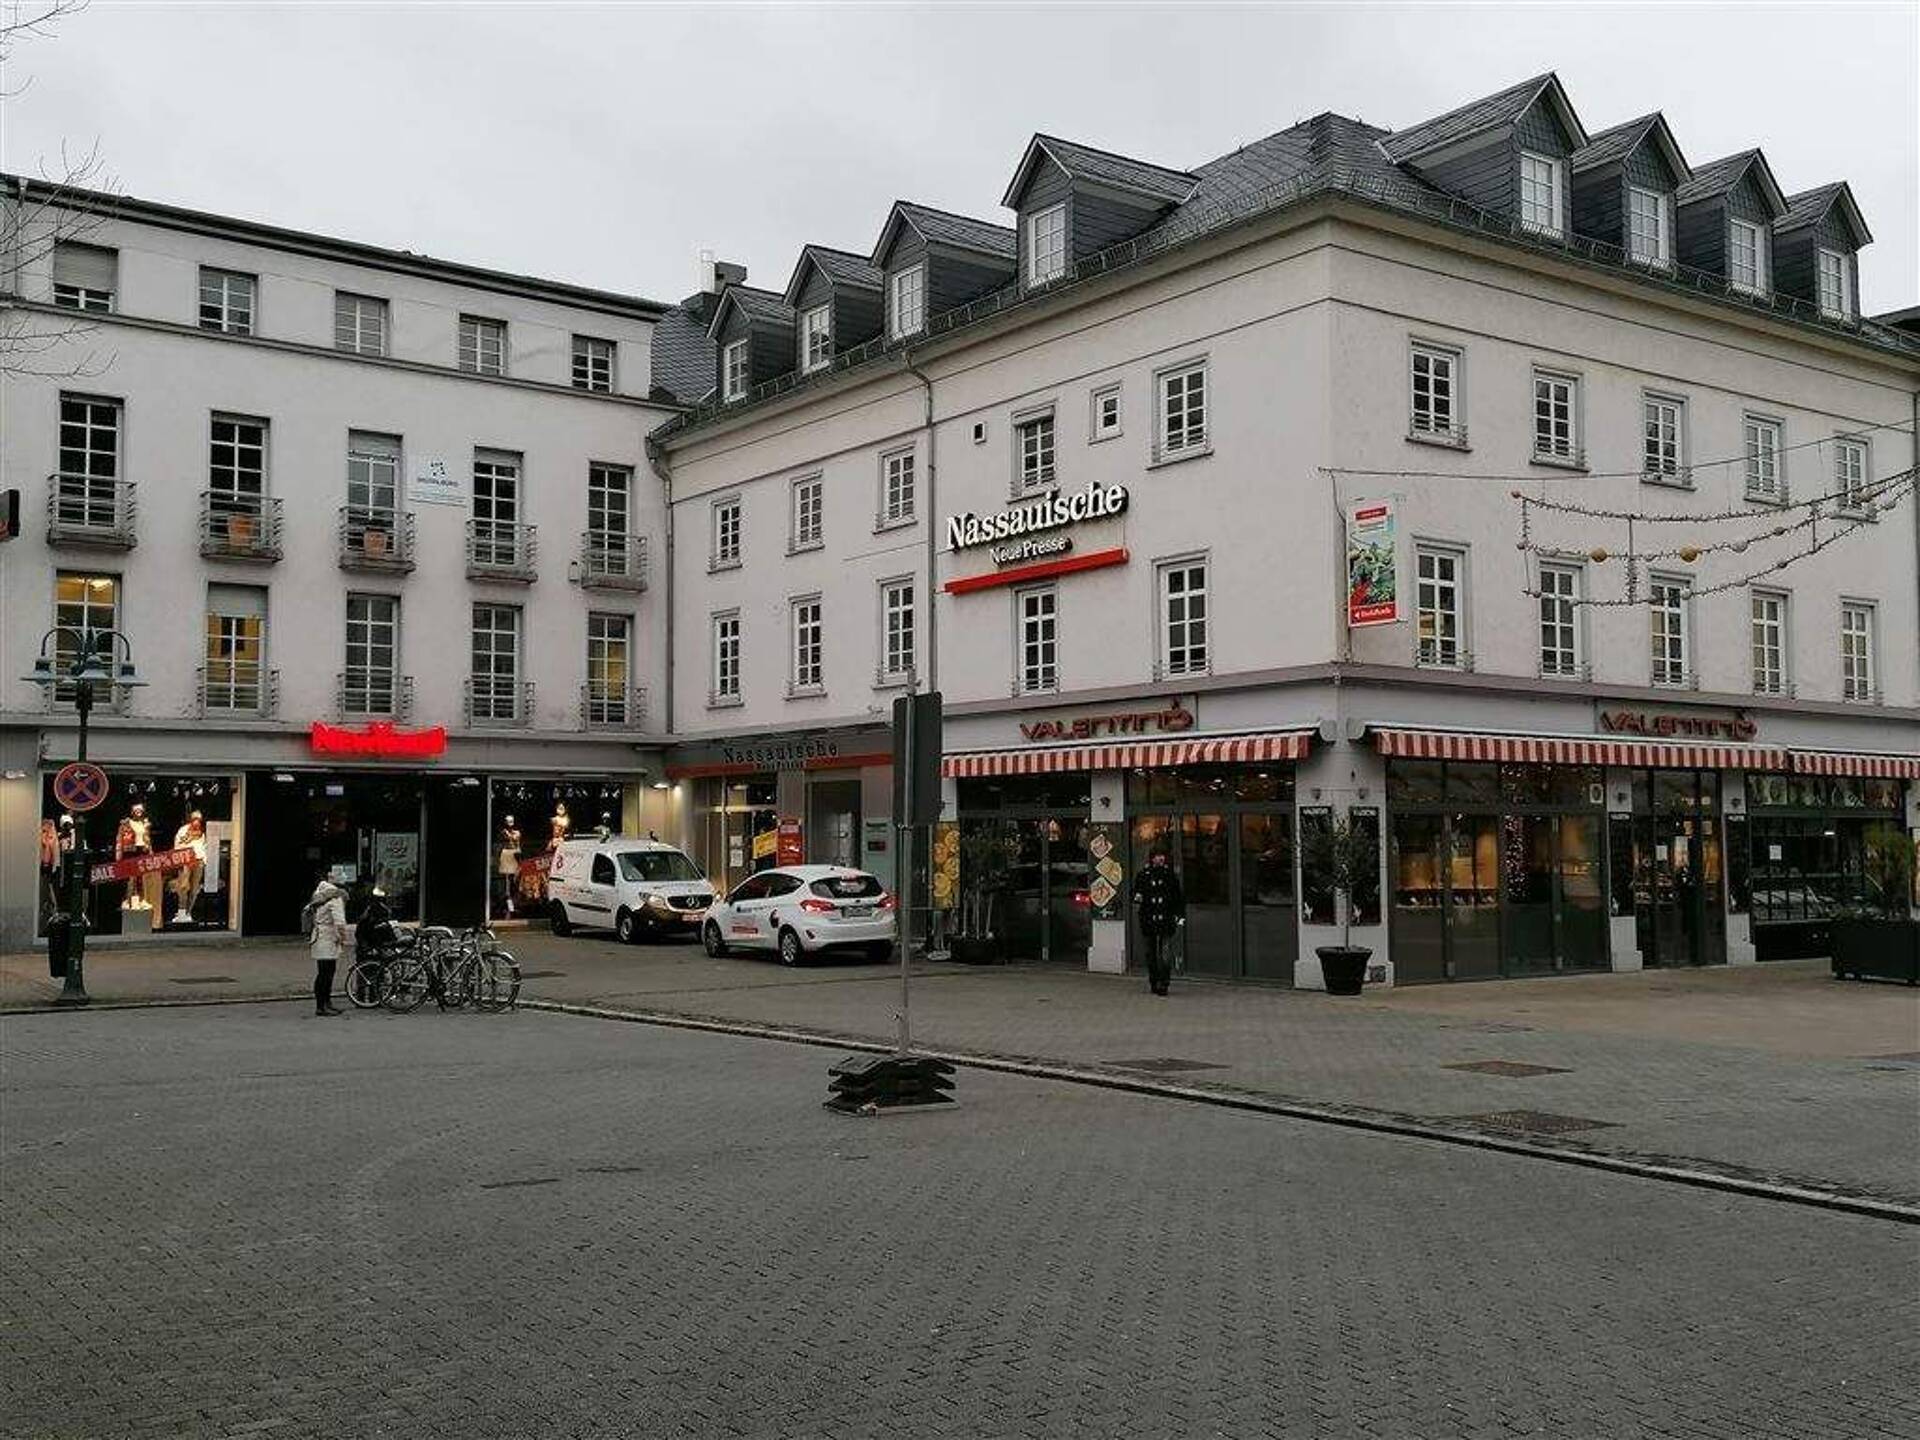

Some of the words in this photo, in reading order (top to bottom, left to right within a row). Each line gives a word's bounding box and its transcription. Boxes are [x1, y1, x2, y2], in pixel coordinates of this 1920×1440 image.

[945, 482, 1127, 551] Nassauische
[990, 546, 1023, 567] Neue
[1023, 537, 1070, 563] Presse
[723, 741, 838, 764] Nassauische
